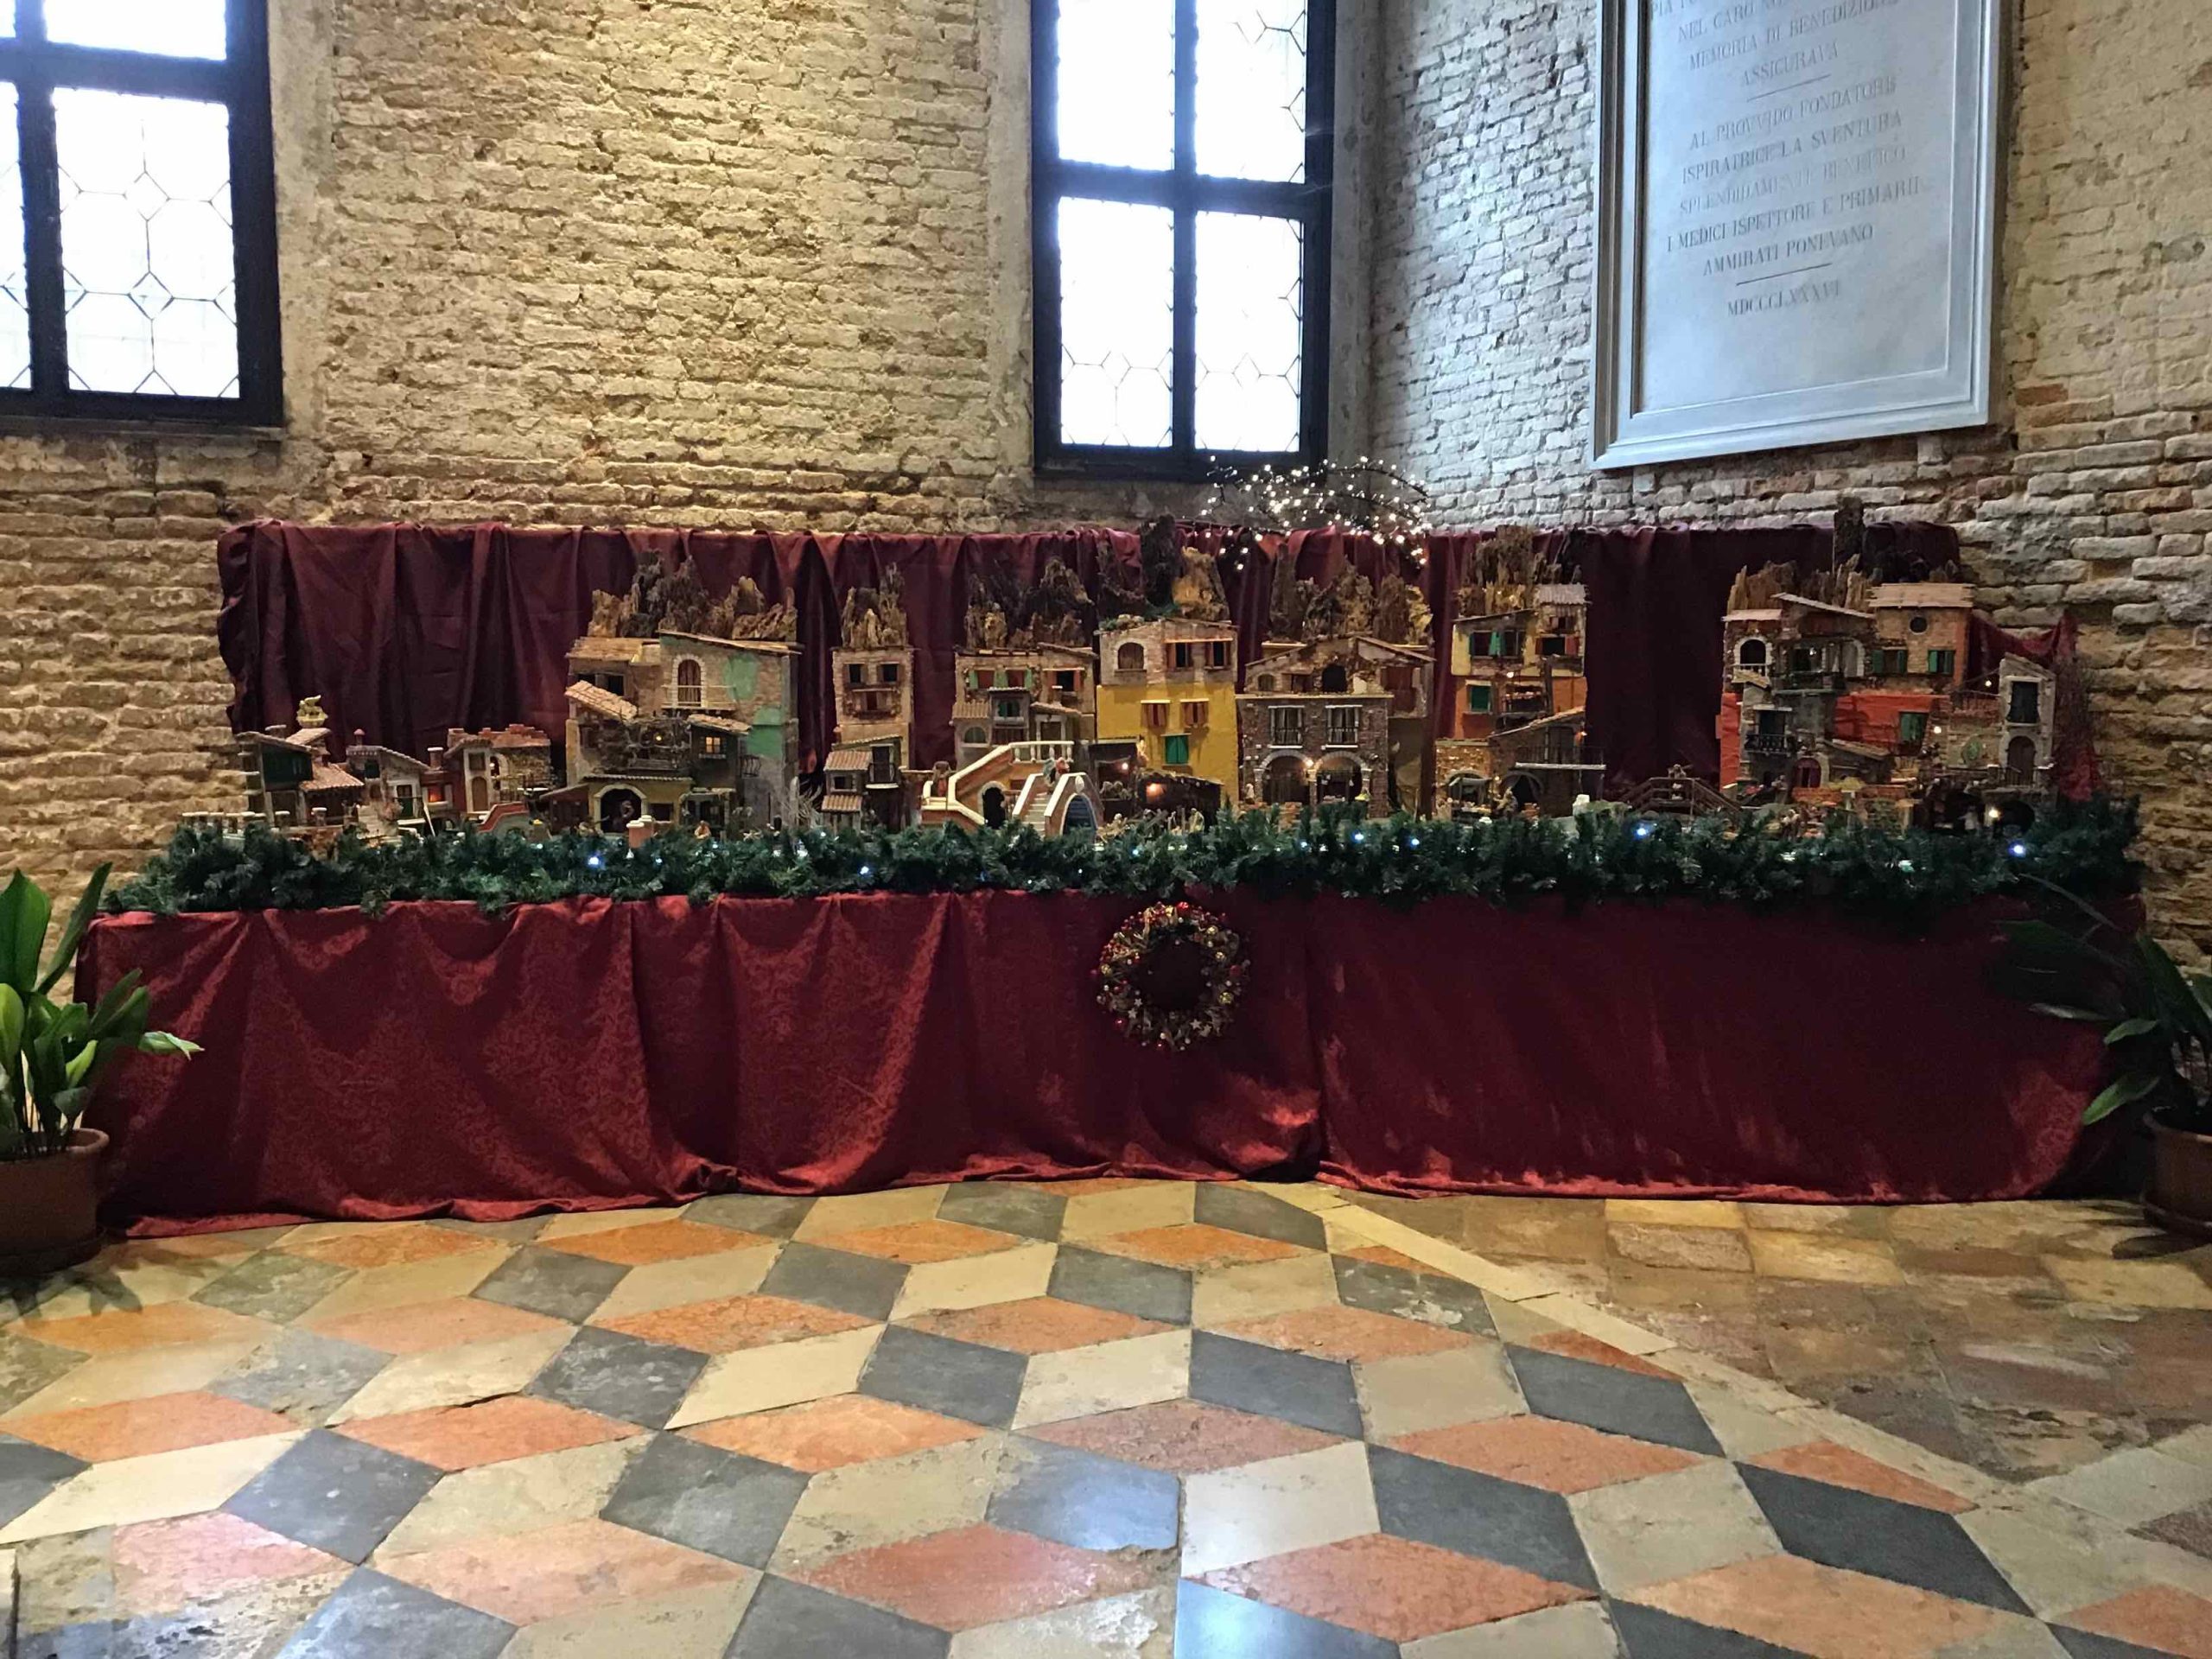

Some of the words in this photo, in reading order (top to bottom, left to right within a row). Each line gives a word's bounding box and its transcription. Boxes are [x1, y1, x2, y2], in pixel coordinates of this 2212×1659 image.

[1678, 19, 1707, 42] NEL
[1689, 35, 1758, 71] MEMORIA
[1766, 26, 1780, 43] DI
[1790, 0, 1898, 37] BENEDIZIO
[1743, 41, 1839, 86] ASSICURAVA
[1682, 145, 1770, 184] ISPIRATRICE
[1780, 138, 1802, 158] LA
[1811, 110, 1901, 148] SVENTURA
[1689, 133, 1708, 150] AL
[1717, 106, 1792, 141] PROVVIDO
[1801, 76, 1897, 118] FONDATORE
[1667, 236, 1673, 252] I
[1679, 223, 1726, 248] MEDICI
[1732, 201, 1814, 238] ISPETTORE
[1822, 198, 1834, 214] E
[1840, 176, 1921, 212] PRIMARII
[1680, 172, 1811, 214] SPLENDIDAMENTE
[1824, 146, 1905, 180] BENEFICO
[1703, 245, 1779, 276] AMMIRATI
[1786, 223, 1873, 257] PONEVANO
